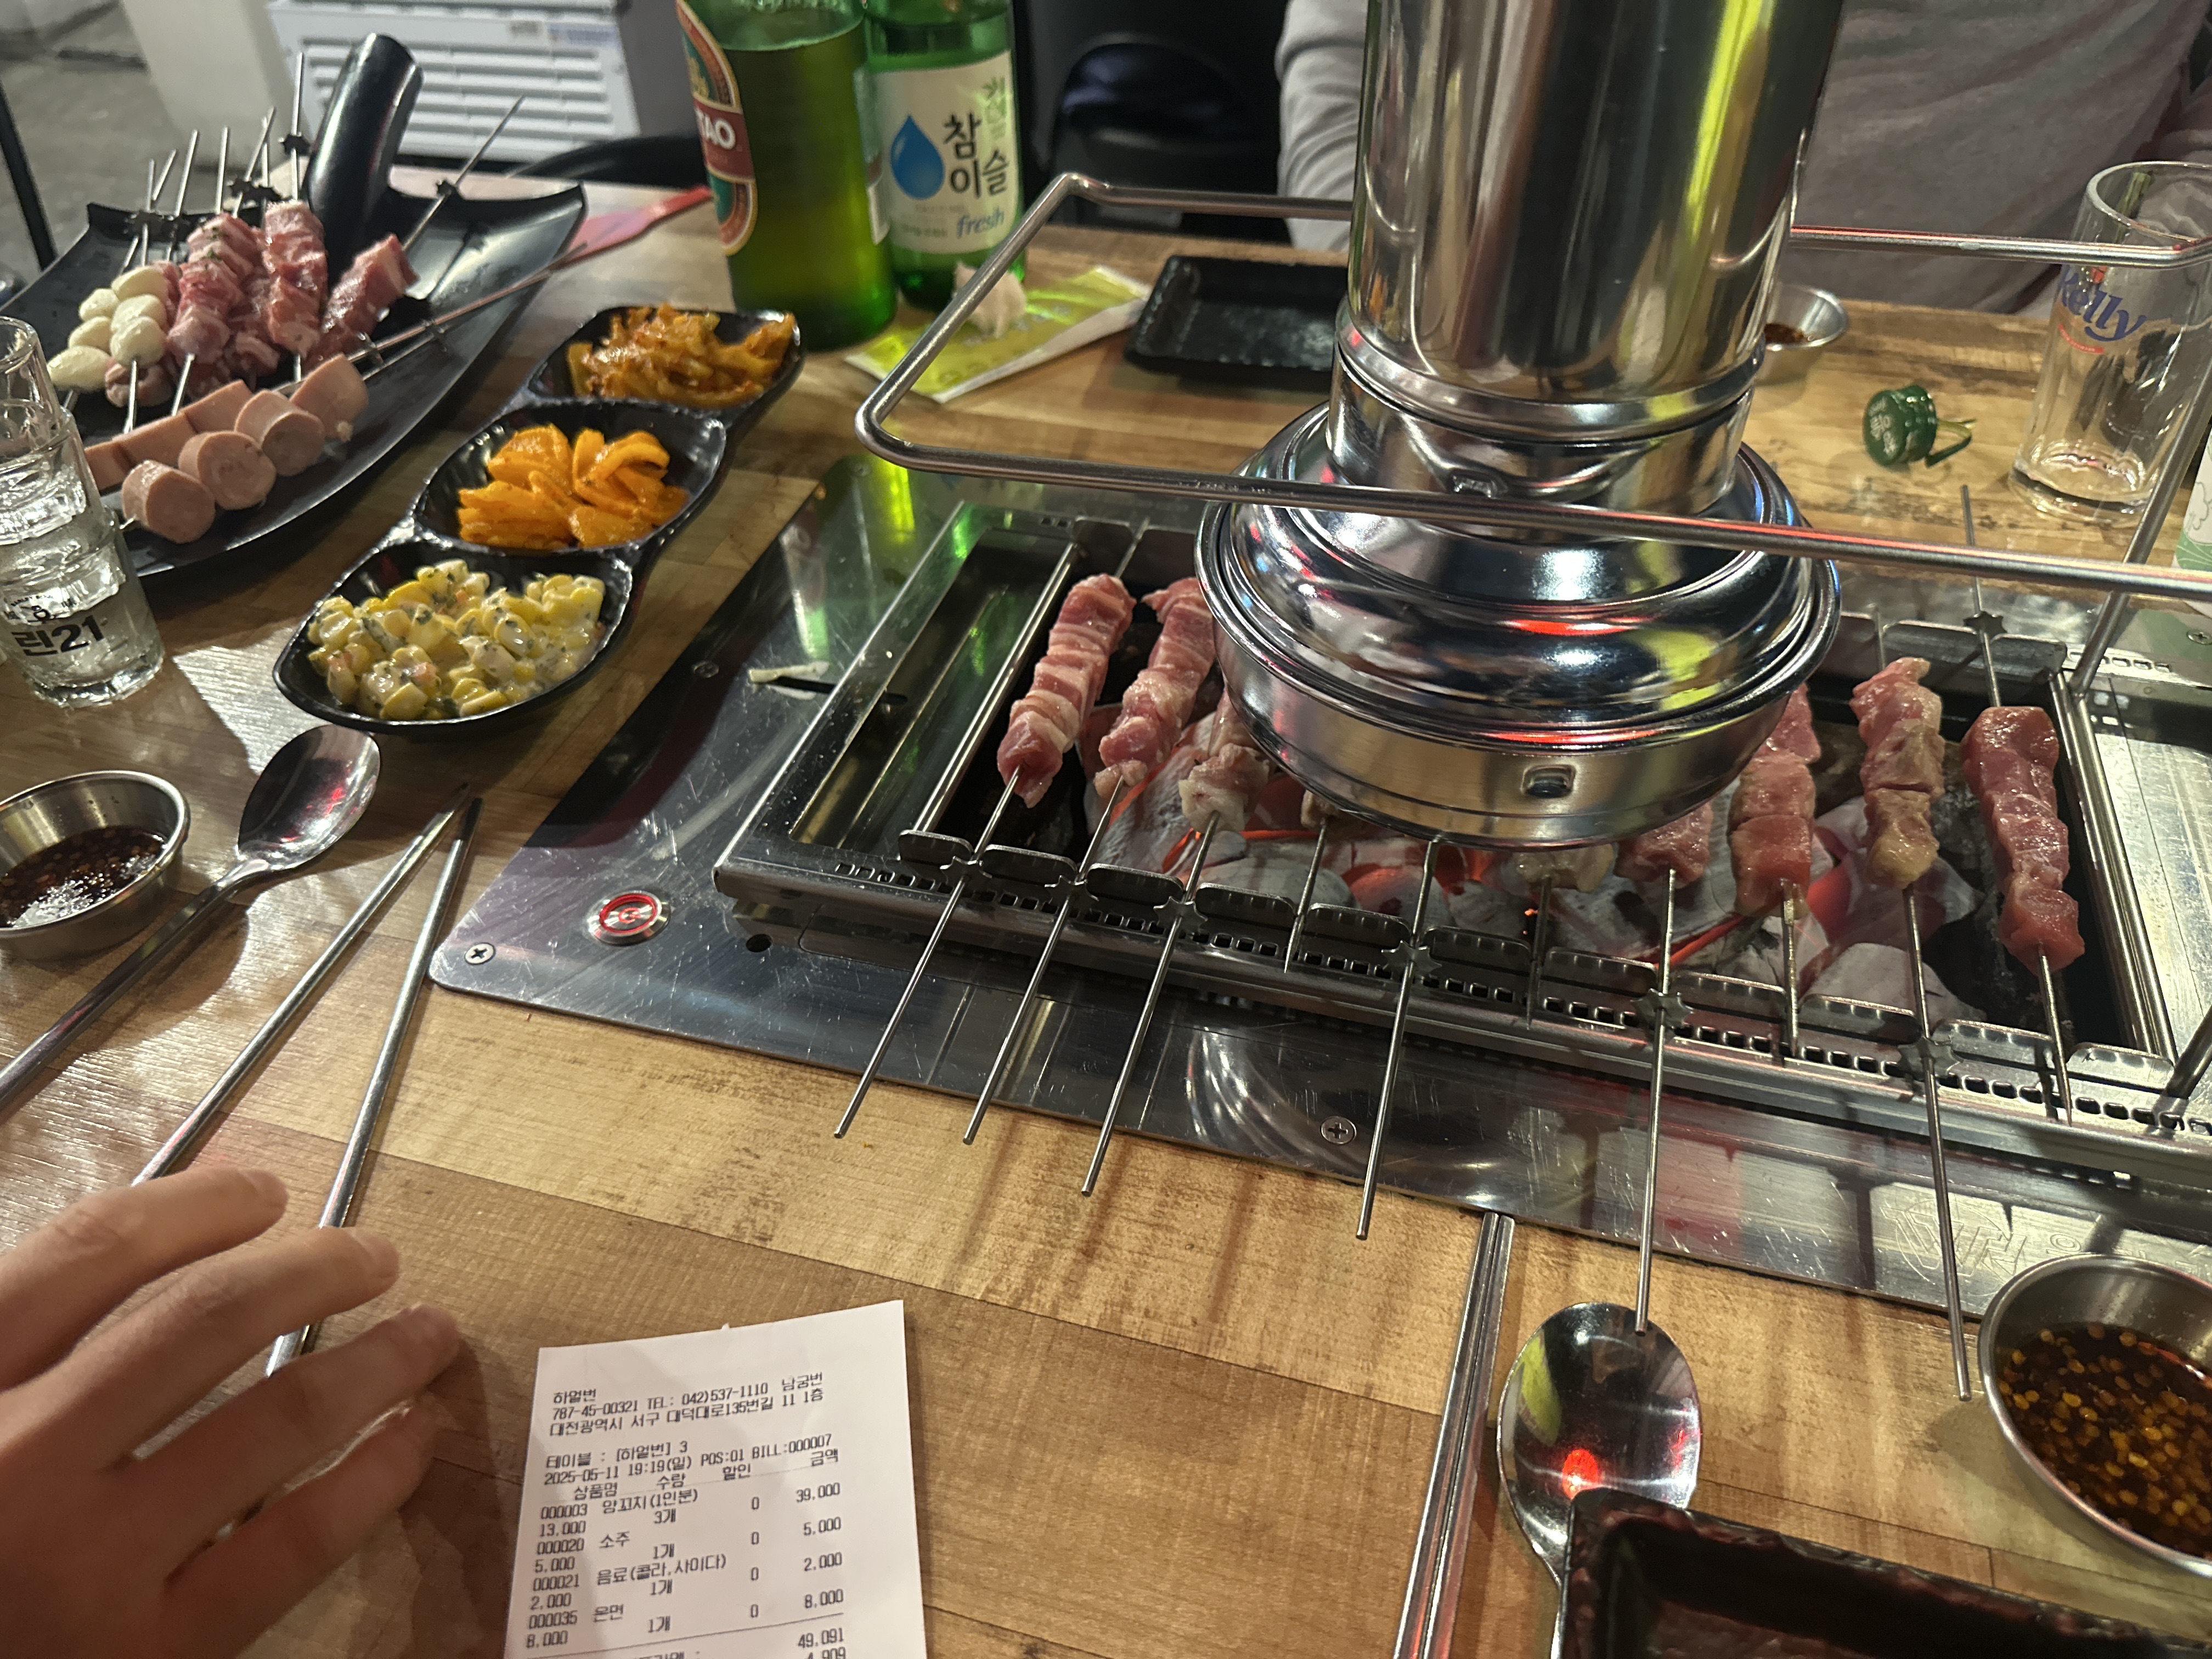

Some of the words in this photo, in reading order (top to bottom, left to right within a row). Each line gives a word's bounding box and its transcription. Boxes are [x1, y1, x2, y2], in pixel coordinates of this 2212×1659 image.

[957, 206, 1005, 239] fresh
[2058, 267, 2147, 342] Kelly
[11, 615, 104, 656] 린21
[553, 1400, 637, 1420] 787-45-00321
[682, 1383, 768, 1405] 042)537-1110
[782, 1372, 822, 1391] 남궁번
[549, 1417, 622, 1436] 대전광역시
[631, 1412, 659, 1426] 서구
[667, 1397, 773, 1423] 대덕대로135번길
[782, 1393, 795, 1407] 11
[804, 1388, 823, 1403] 1층
[544, 1466, 618, 1485] 2025-05-11
[628, 1456, 692, 1476] 19:19(일)
[701, 1449, 744, 1466] POS:01
[752, 1434, 832, 1459] BILL:000007
[546, 1452, 591, 1469] 테이블
[680, 1441, 687, 1453] 3
[575, 1482, 618, 1500] 상품명
[657, 1473, 686, 1490] 수량
[723, 1463, 751, 1481] 할인
[810, 1448, 838, 1466] 금액
[540, 1503, 588, 1520] 000003
[654, 1509, 676, 1524] 3개
[752, 1497, 759, 1510] 0
[537, 1538, 584, 1555] 000020
[599, 1531, 630, 1548] 소주
[653, 1544, 675, 1559] 1개
[751, 1531, 759, 1545] 0
[533, 1573, 579, 1591] 000021
[650, 1579, 673, 1595] 1개
[751, 1567, 759, 1581] 0
[529, 1610, 578, 1629] 000035
[648, 1616, 670, 1633] 1개
[751, 1604, 759, 1617] 0
